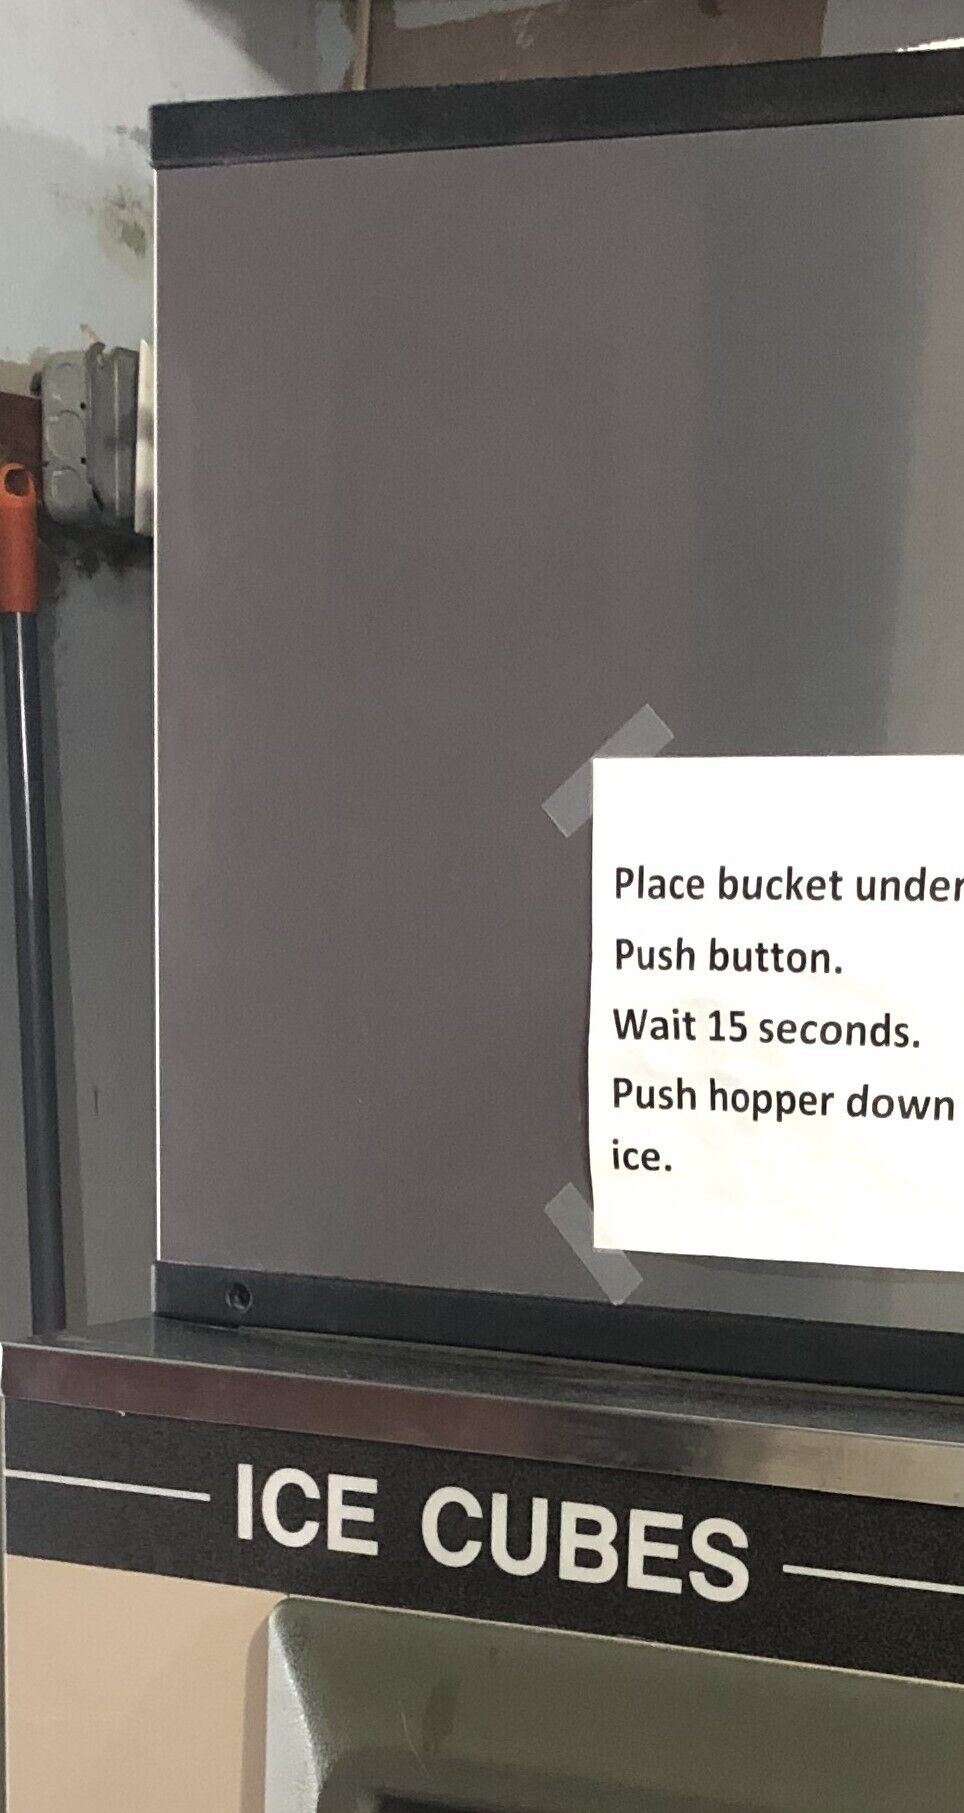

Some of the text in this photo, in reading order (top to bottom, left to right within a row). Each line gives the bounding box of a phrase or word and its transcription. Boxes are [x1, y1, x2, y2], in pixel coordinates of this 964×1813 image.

[614, 866, 705, 901] Place
[718, 866, 843, 902] bucket
[615, 938, 843, 975] Push button.
[613, 1008, 921, 1049] Wait 15 seconds.
[612, 1077, 697, 1111] Push
[709, 1078, 834, 1123] hopper
[846, 1084, 956, 1122] down
[612, 1139, 673, 1172] ice.
[237, 1463, 750, 1603] ICE CUBES
